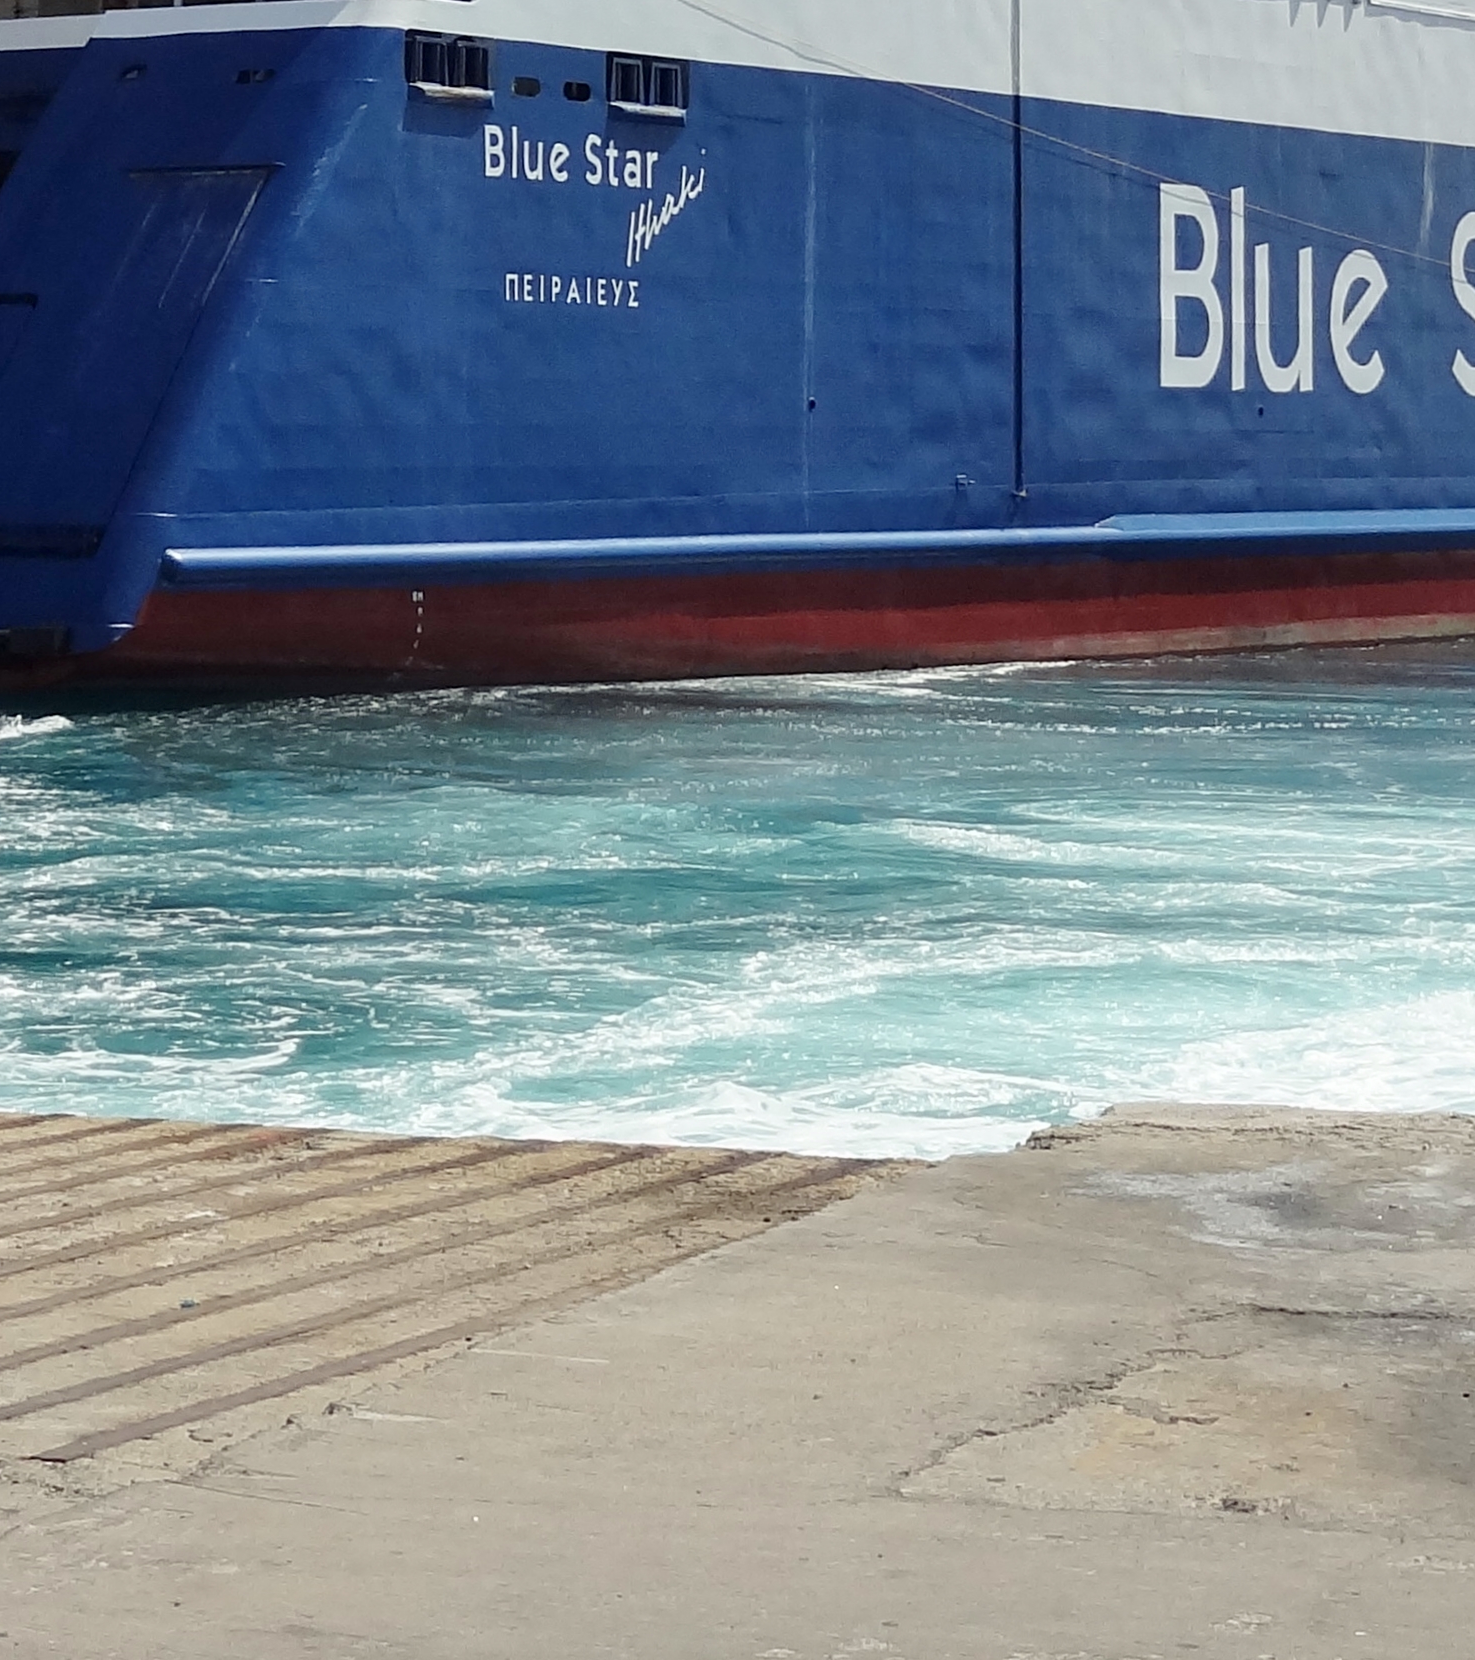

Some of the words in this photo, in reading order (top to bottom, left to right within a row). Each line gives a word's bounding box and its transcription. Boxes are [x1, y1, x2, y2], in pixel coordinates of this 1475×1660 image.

[483, 124, 570, 182] Blue
[584, 133, 659, 189] Star
[504, 272, 641, 308] ΠΕΙΡΑΙΕΥΣ
[1158, 182, 1390, 395] Blue
